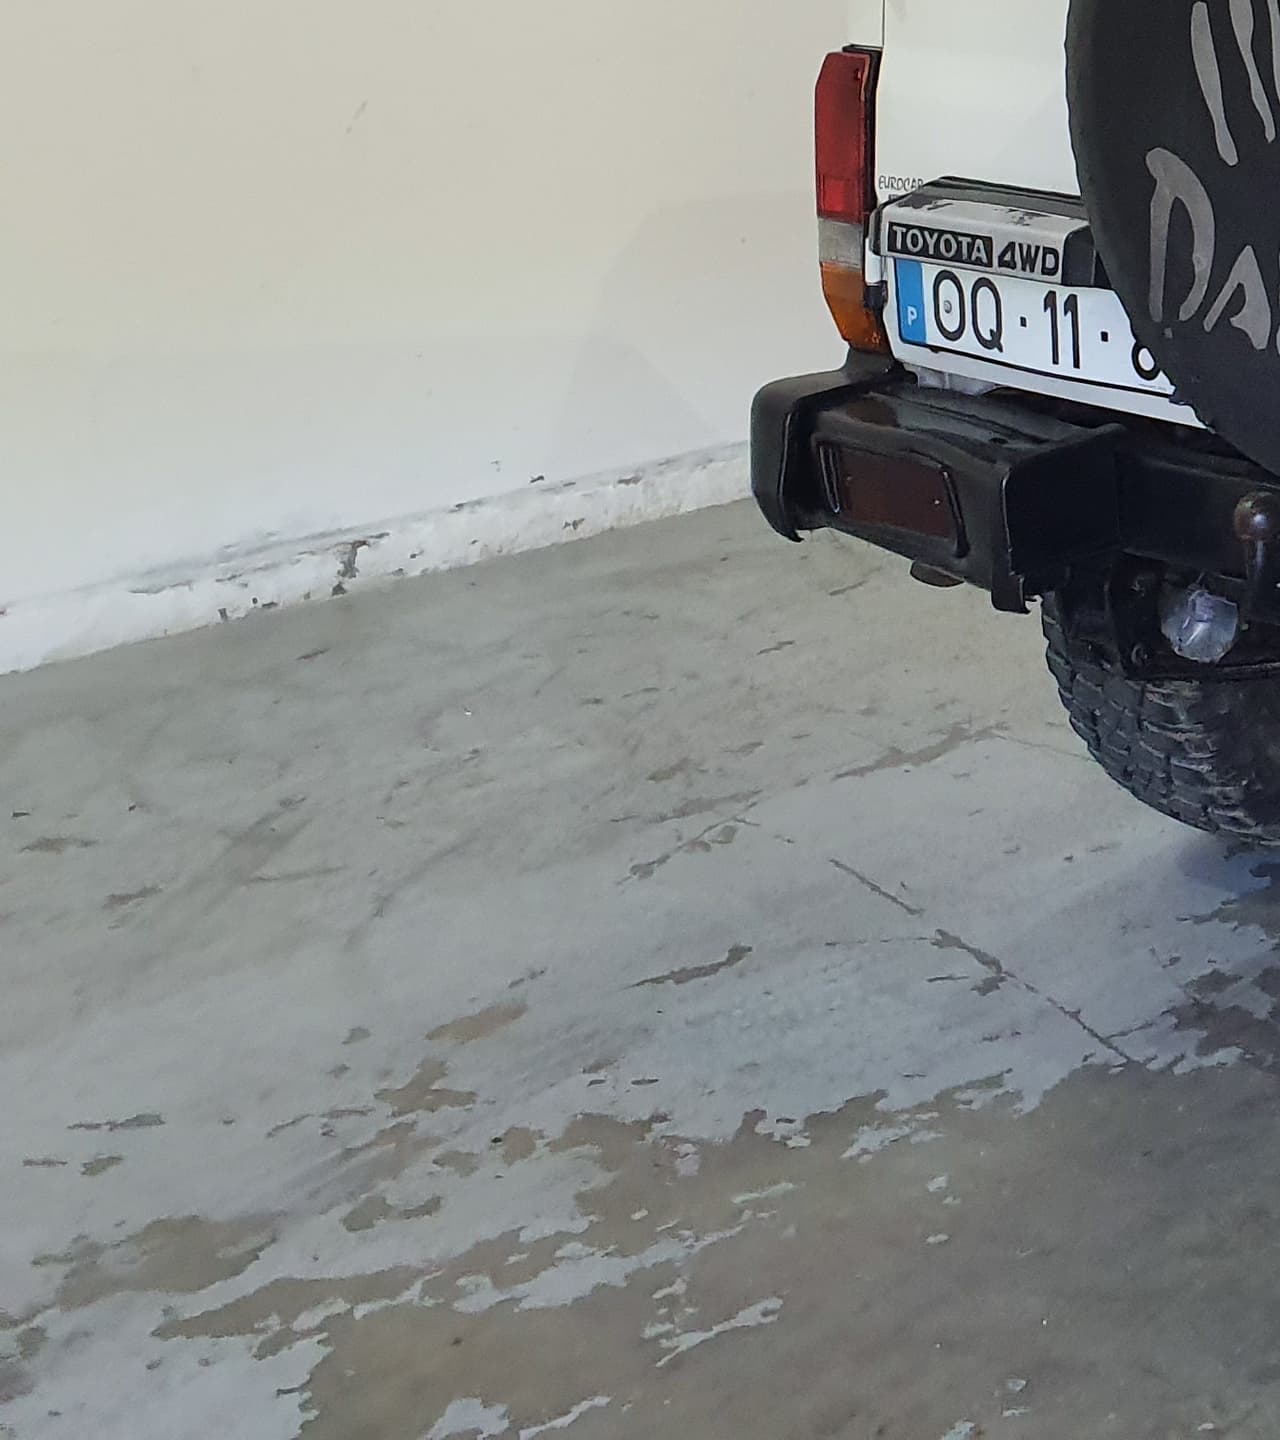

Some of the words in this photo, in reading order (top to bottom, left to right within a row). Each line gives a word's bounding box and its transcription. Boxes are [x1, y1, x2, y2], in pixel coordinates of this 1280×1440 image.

[891, 225, 988, 263] TOYOTA
[997, 240, 1060, 276] 4WD
[907, 306, 918, 326] P
